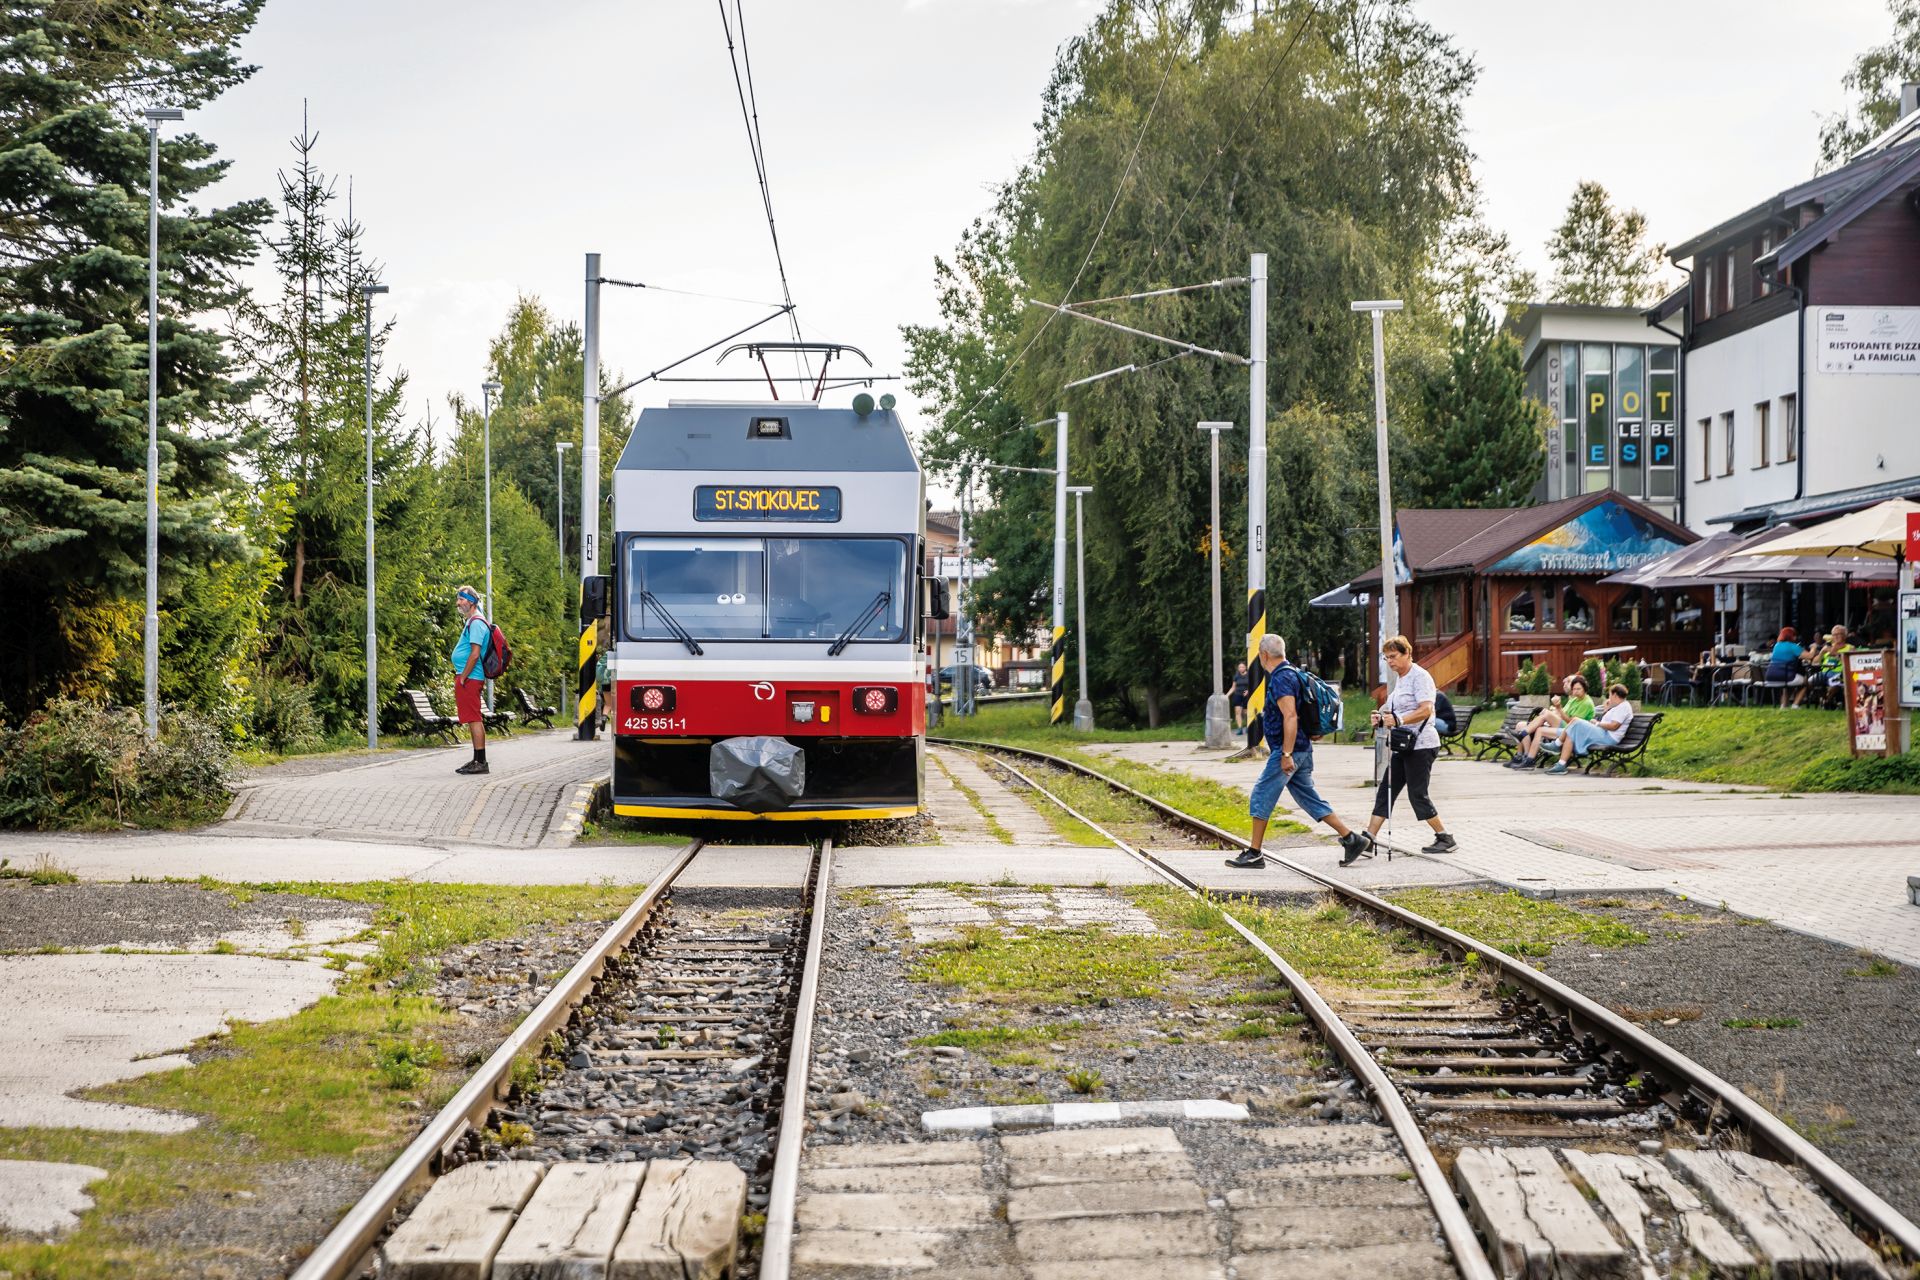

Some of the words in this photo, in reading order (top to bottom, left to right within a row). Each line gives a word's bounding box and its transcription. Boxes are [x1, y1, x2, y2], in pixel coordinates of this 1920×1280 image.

[1829, 341, 1892, 351] RISTORANTE
[1853, 353, 1865, 361] LA
[1868, 353, 1916, 361] FAMIGLIA
[954, 649, 967, 663] 15
[624, 717, 648, 730] 425
[651, 717, 687, 730] 951-1
